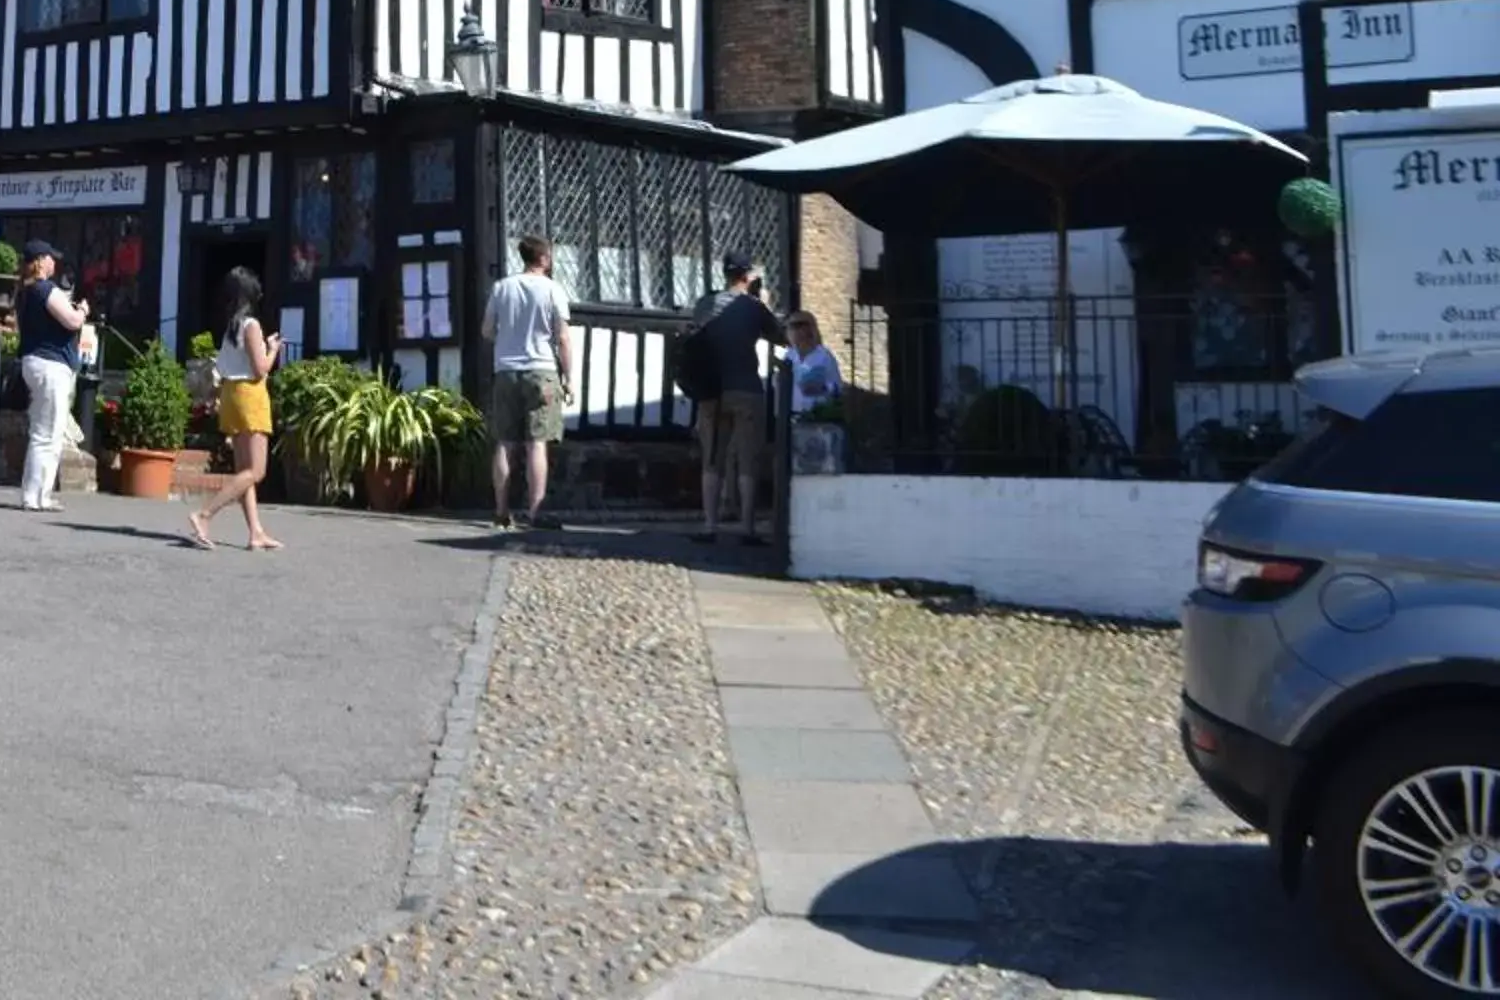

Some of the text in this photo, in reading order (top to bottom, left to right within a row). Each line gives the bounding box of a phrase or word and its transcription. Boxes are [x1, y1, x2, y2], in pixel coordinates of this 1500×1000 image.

[1188, 8, 1403, 57] Merma Inn
[1437, 246, 1474, 265] AA
